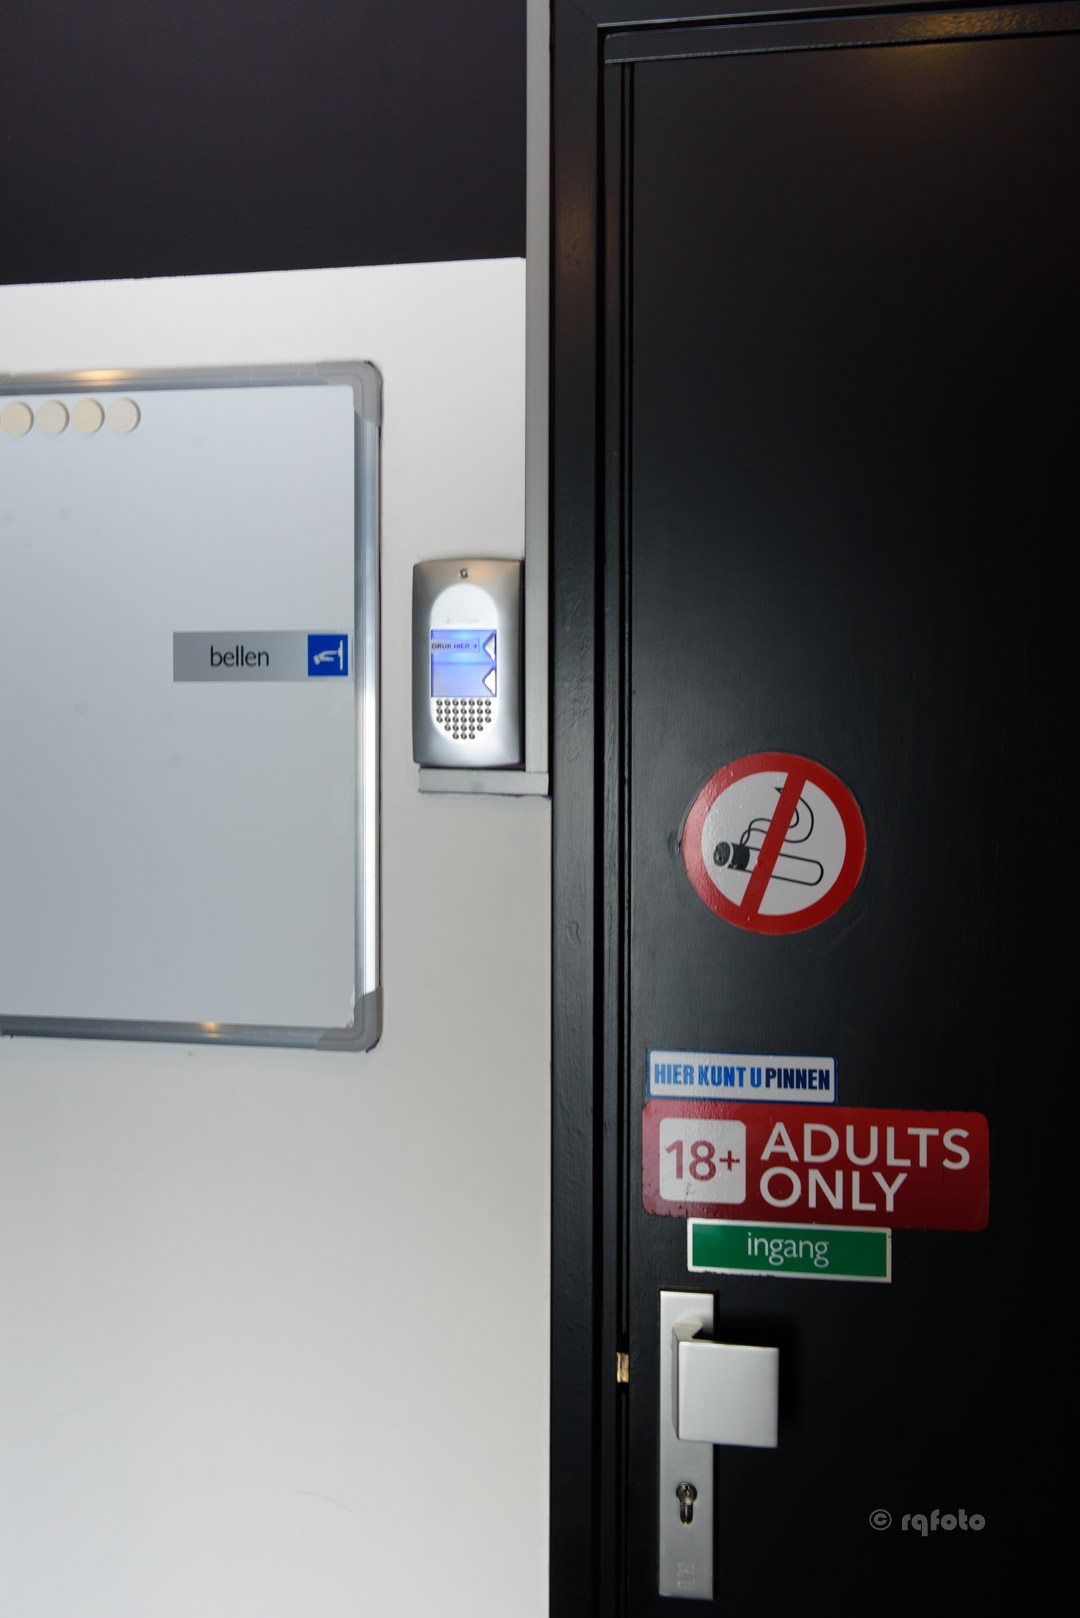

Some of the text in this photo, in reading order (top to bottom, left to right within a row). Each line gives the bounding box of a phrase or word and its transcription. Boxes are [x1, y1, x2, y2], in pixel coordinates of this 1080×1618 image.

[210, 645, 270, 667] bellen
[654, 1063, 830, 1090] HIER KUNT U PINNEN
[664, 1139, 741, 1181] 18+
[760, 1121, 970, 1170] ADULTS
[759, 1166, 908, 1213] ONLY
[747, 1231, 829, 1268] ingang
